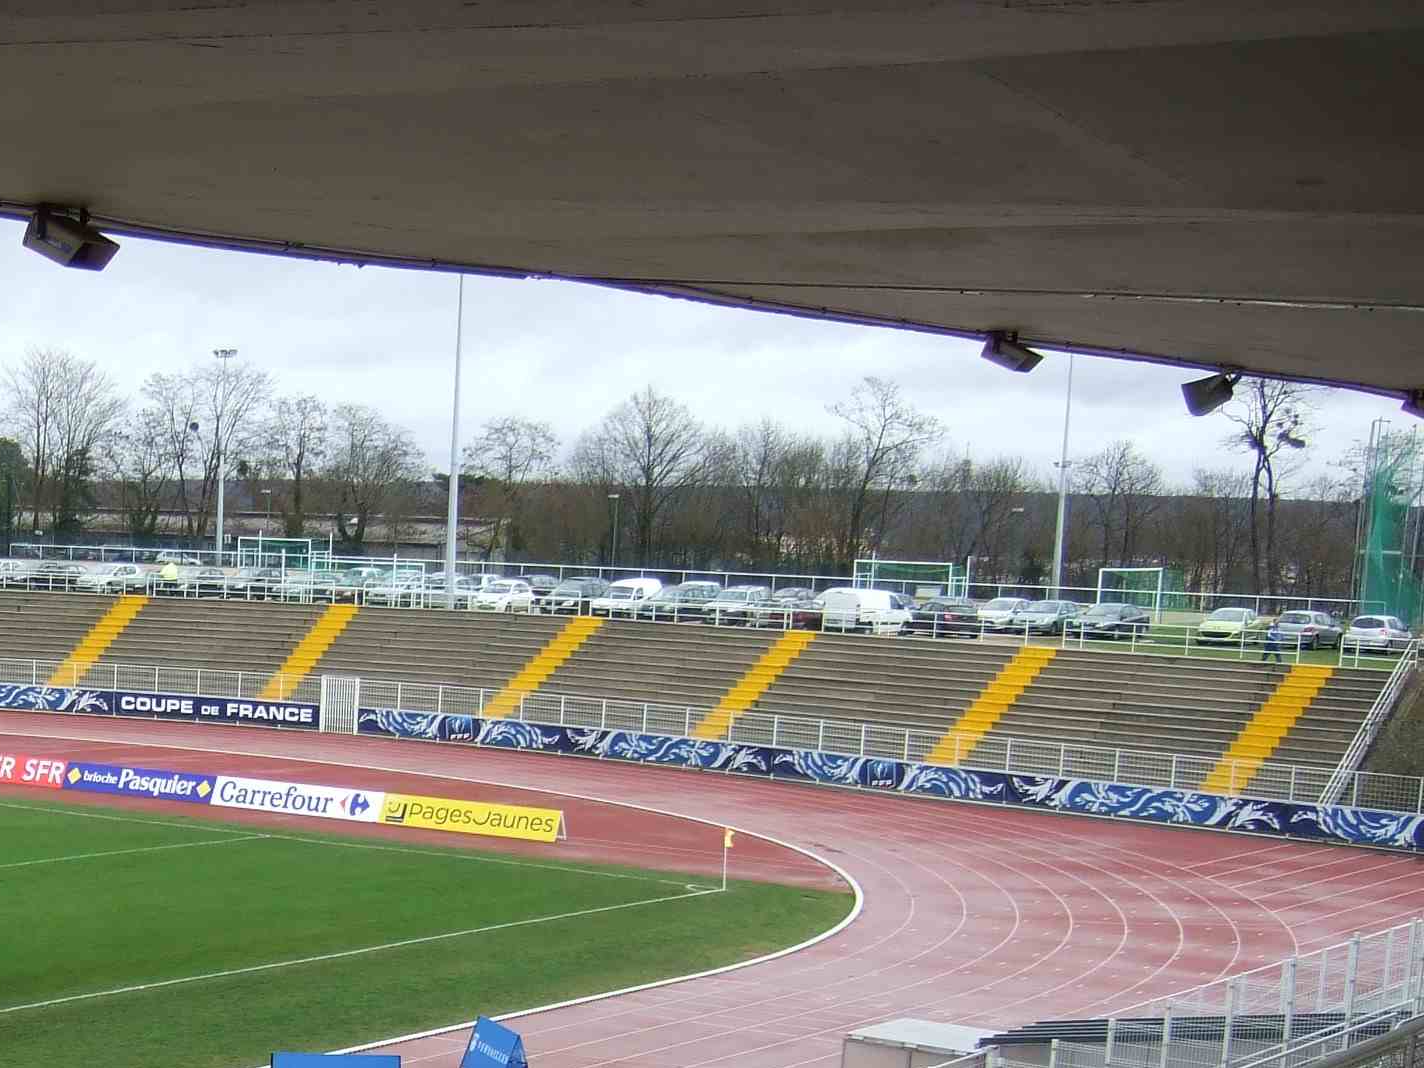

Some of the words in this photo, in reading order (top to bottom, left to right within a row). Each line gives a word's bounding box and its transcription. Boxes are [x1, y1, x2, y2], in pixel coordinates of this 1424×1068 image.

[121, 696, 194, 714] COUPE
[201, 705, 220, 716] DE
[226, 703, 313, 722] FRANCE
[22, 758, 65, 784] SFR
[83, 770, 119, 785] brioche
[118, 768, 197, 797] Pasquier
[220, 780, 334, 813] Carrefour
[409, 801, 555, 833] PagesJaunes
